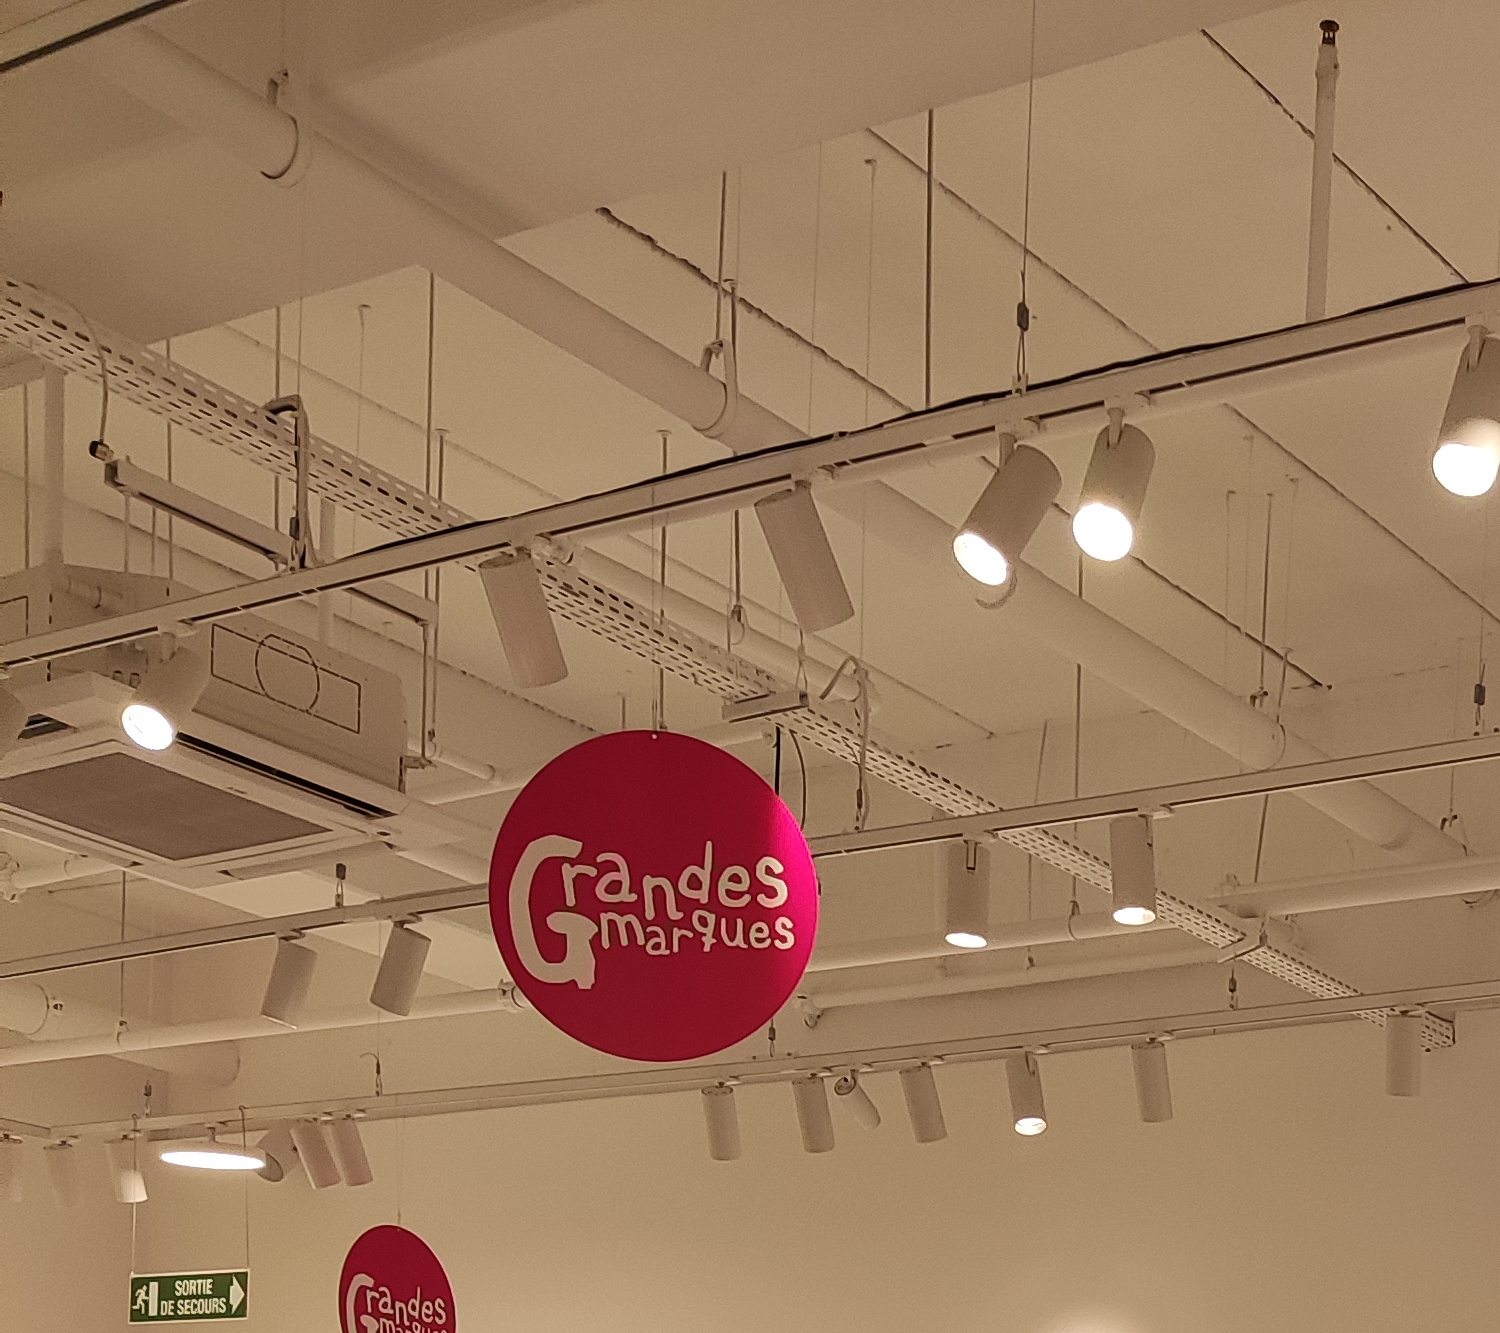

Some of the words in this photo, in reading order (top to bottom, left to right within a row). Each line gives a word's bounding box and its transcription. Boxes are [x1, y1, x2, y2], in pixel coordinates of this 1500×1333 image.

[509, 835, 788, 989] Grandes
[600, 909, 795, 955] marques
[174, 1278, 214, 1297] SORTIE
[160, 1301, 175, 1317] DE
[176, 1297, 227, 1316] SECOURS
